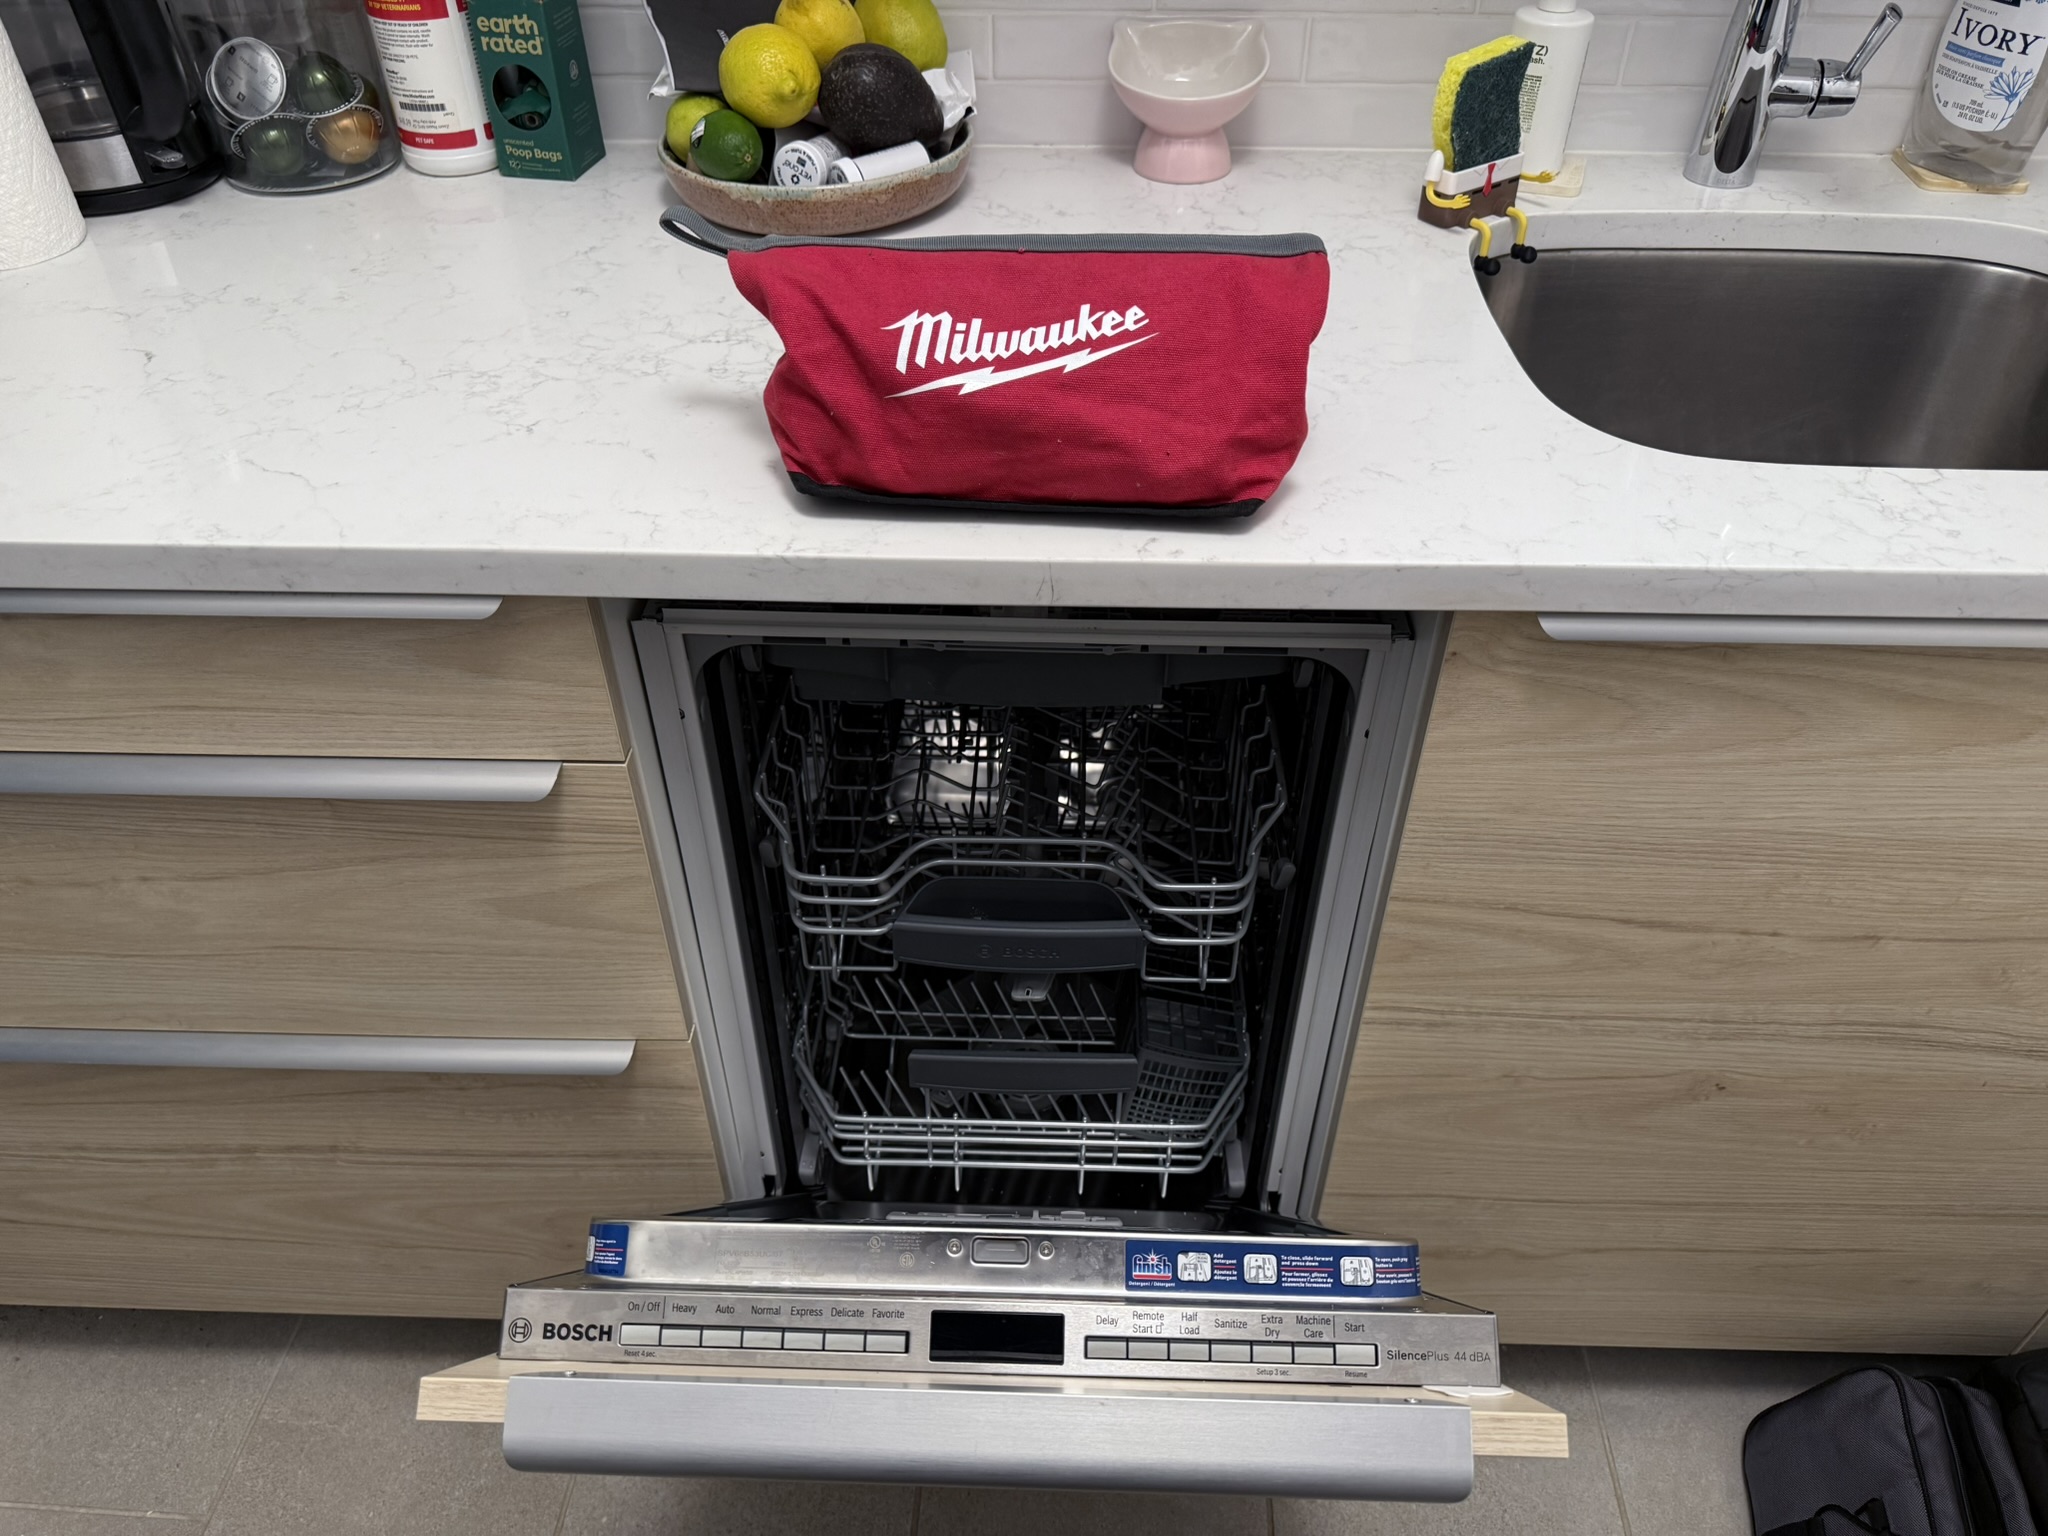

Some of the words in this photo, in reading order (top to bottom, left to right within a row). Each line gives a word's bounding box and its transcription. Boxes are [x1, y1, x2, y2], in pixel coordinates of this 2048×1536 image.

[382, 3, 421, 11] VETERINARIANS
[476, 14, 539, 36] earth
[481, 34, 543, 56] rated
[1974, 64, 1998, 75] VAISSELLE
[1943, 72, 1956, 80] POUR
[1962, 80, 1984, 89] GRAISSE
[1957, 72, 1977, 82] GREASE
[1963, 112, 1968, 120] FL
[503, 139, 534, 147] unscented
[505, 145, 533, 160] Poop
[534, 148, 563, 163] Bags
[798, 170, 813, 182] VET
[880, 304, 1149, 375] Milwaukee
[1002, 946, 1060, 959] BOSCH
[1132, 1253, 1172, 1275] finish
[628, 1302, 639, 1312] On
[640, 1302, 646, 1312] /
[647, 1302, 661, 1312] Off
[672, 1303, 698, 1315] Heavy
[715, 1304, 735, 1314] Auto
[751, 1305, 781, 1316] Normal
[790, 1306, 824, 1318] Express
[831, 1307, 865, 1318] Delicate
[872, 1308, 905, 1319] Favorite
[1132, 1310, 1165, 1321] Remote
[1181, 1311, 1198, 1321] Half
[1261, 1314, 1283, 1324] Extra
[1096, 1315, 1119, 1327] Delay
[1214, 1318, 1248, 1329] Sanitize
[1296, 1315, 1331, 1326] Machine
[542, 1322, 613, 1342] BOSCH
[1132, 1323, 1153, 1334] Start
[1179, 1325, 1200, 1335] Load
[1265, 1327, 1281, 1339] Dry
[1304, 1328, 1324, 1338] Care
[1344, 1323, 1365, 1332] Start
[624, 1349, 640, 1357] Reset
[1386, 1350, 1450, 1362] SilencePlus
[1454, 1351, 1467, 1361] 44
[1469, 1351, 1491, 1362] dBA
[1256, 1368, 1274, 1376] Setup
[1344, 1370, 1368, 1378] Resume
